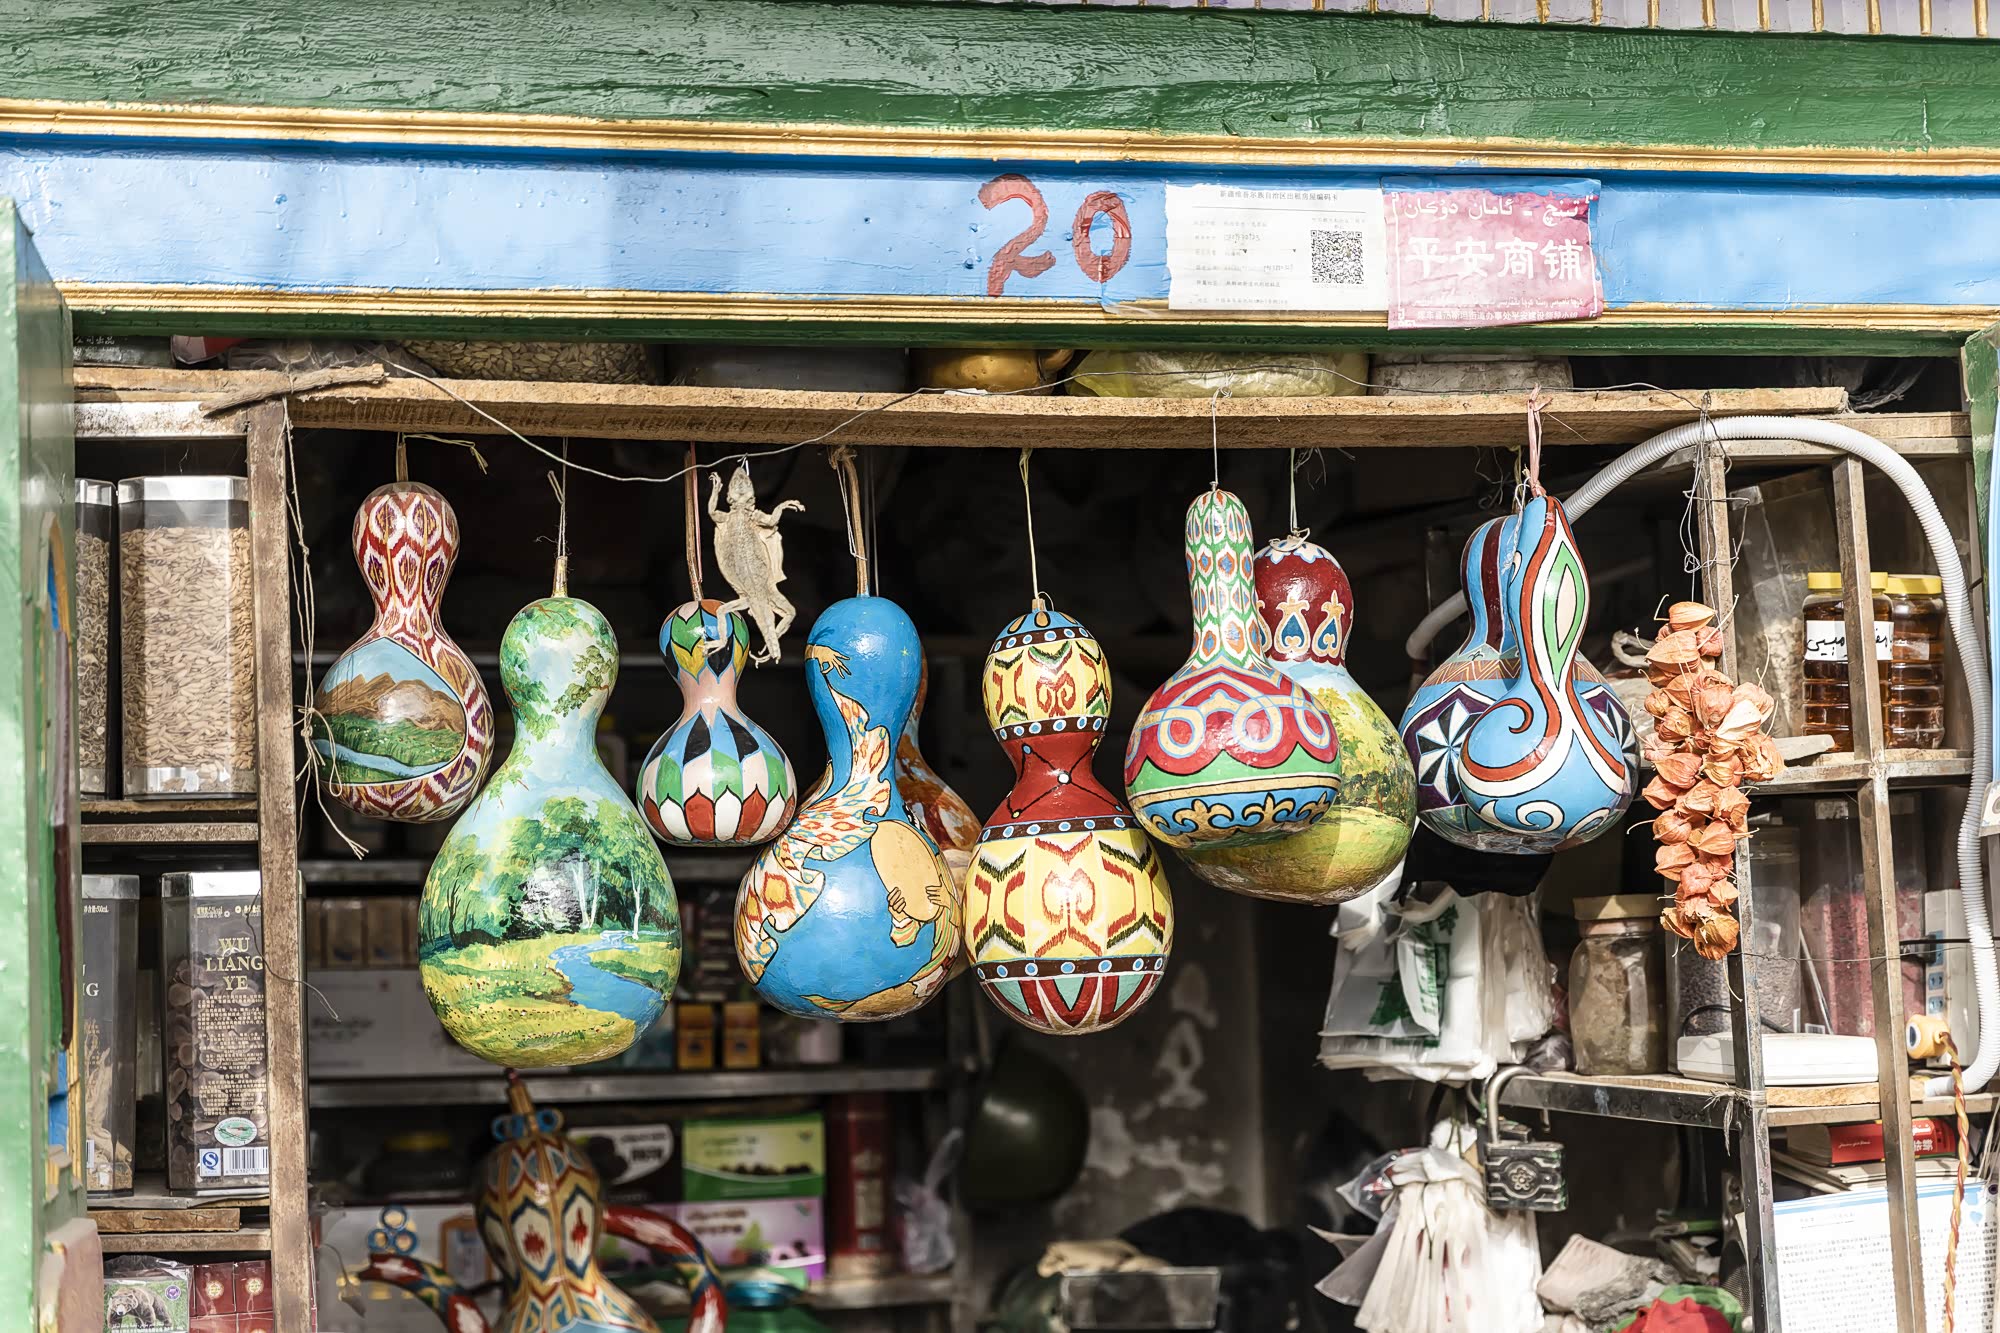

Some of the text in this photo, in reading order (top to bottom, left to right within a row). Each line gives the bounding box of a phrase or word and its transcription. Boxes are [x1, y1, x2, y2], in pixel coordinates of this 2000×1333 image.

[978, 173, 1132, 297] 20
[1403, 235, 1584, 281] 平安商铺
[218, 937, 250, 956] WU
[205, 956, 264, 972] LIANG
[223, 975, 248, 991] YE
